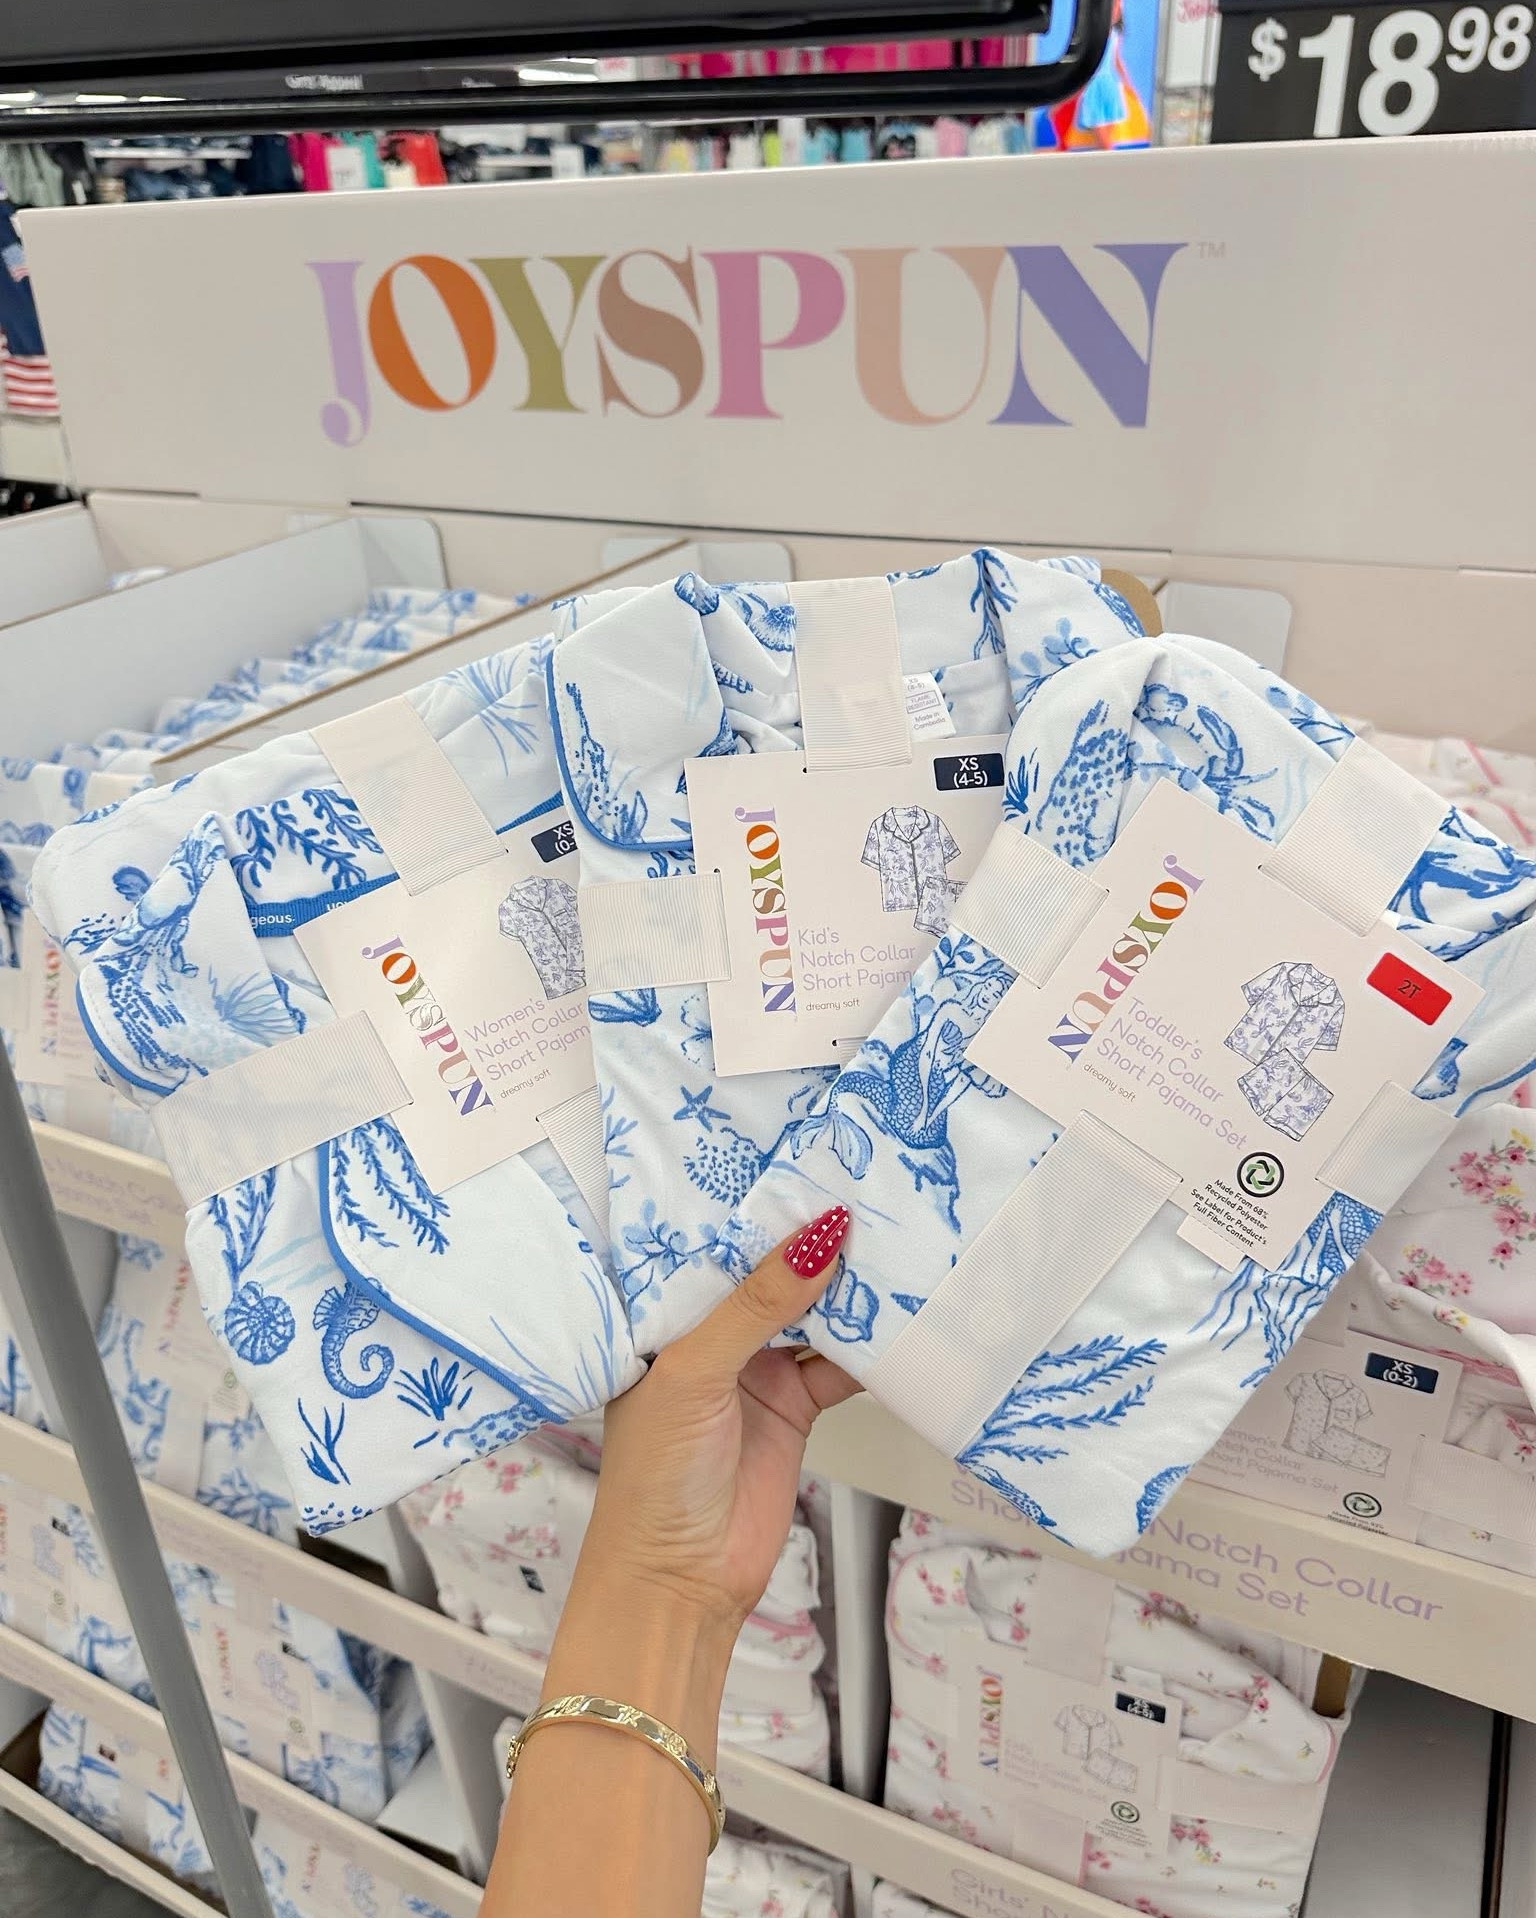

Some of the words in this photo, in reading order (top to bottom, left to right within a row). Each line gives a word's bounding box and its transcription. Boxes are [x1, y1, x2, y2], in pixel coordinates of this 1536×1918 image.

[303, 242, 1191, 448] JOYSPUN
[953, 770, 988, 788] (4-5)
[959, 757, 979, 771] XS
[553, 823, 574, 840] XS
[555, 837, 575, 854] (0-
[735, 806, 797, 1014] JOYSPUN
[798, 926, 840, 946] Kid's
[801, 947, 855, 969] Notch
[860, 944, 916, 962] Collar
[1048, 854, 1205, 1064] JOYSPUN
[803, 971, 852, 991] Short
[857, 969, 915, 989] Pajam
[1397, 979, 1422, 999] 2T
[464, 997, 546, 1043] Women's
[805, 999, 841, 1012] dreamy
[843, 998, 860, 1009] soft
[361, 936, 494, 1116] JOYSPUN
[474, 1028, 530, 1062] Notch
[532, 1003, 584, 1034] Collar
[1128, 997, 1203, 1060] Toddler's
[486, 1051, 537, 1081] Short
[1110, 1017, 1164, 1065] Notch
[1168, 1057, 1223, 1102] Collar
[500, 1075, 534, 1100] dreamy
[534, 1068, 551, 1083] soft
[1083, 1063, 1118, 1091] dreamy
[1117, 1086, 1136, 1102] soft
[1097, 1037, 1146, 1081] Short
[1146, 1071, 1214, 1127] Pajama
[1215, 1119, 1248, 1150] Set
[1190, 1188, 1205, 1201] See
[1204, 1197, 1224, 1215] Label
[1223, 1211, 1236, 1222] for
[1235, 1219, 1267, 1245] Product's
[1204, 1183, 1237, 1209] Recycled
[1236, 1205, 1268, 1230] Polyester
[1214, 1179, 1234, 1196] Made
[1234, 1192, 1253, 1209] From
[1252, 1205, 1269, 1220] 68%
[1193, 1202, 1206, 1215] Full
[1206, 1211, 1226, 1227] Fiber
[1225, 1224, 1254, 1248] Content
[1382, 1369, 1419, 1388] (0-2)
[1391, 1360, 1414, 1375] XS
[1149, 1514, 1278, 1574] Notch
[1295, 1557, 1444, 1621] Collar
[1236, 1572, 1309, 1617] Set
